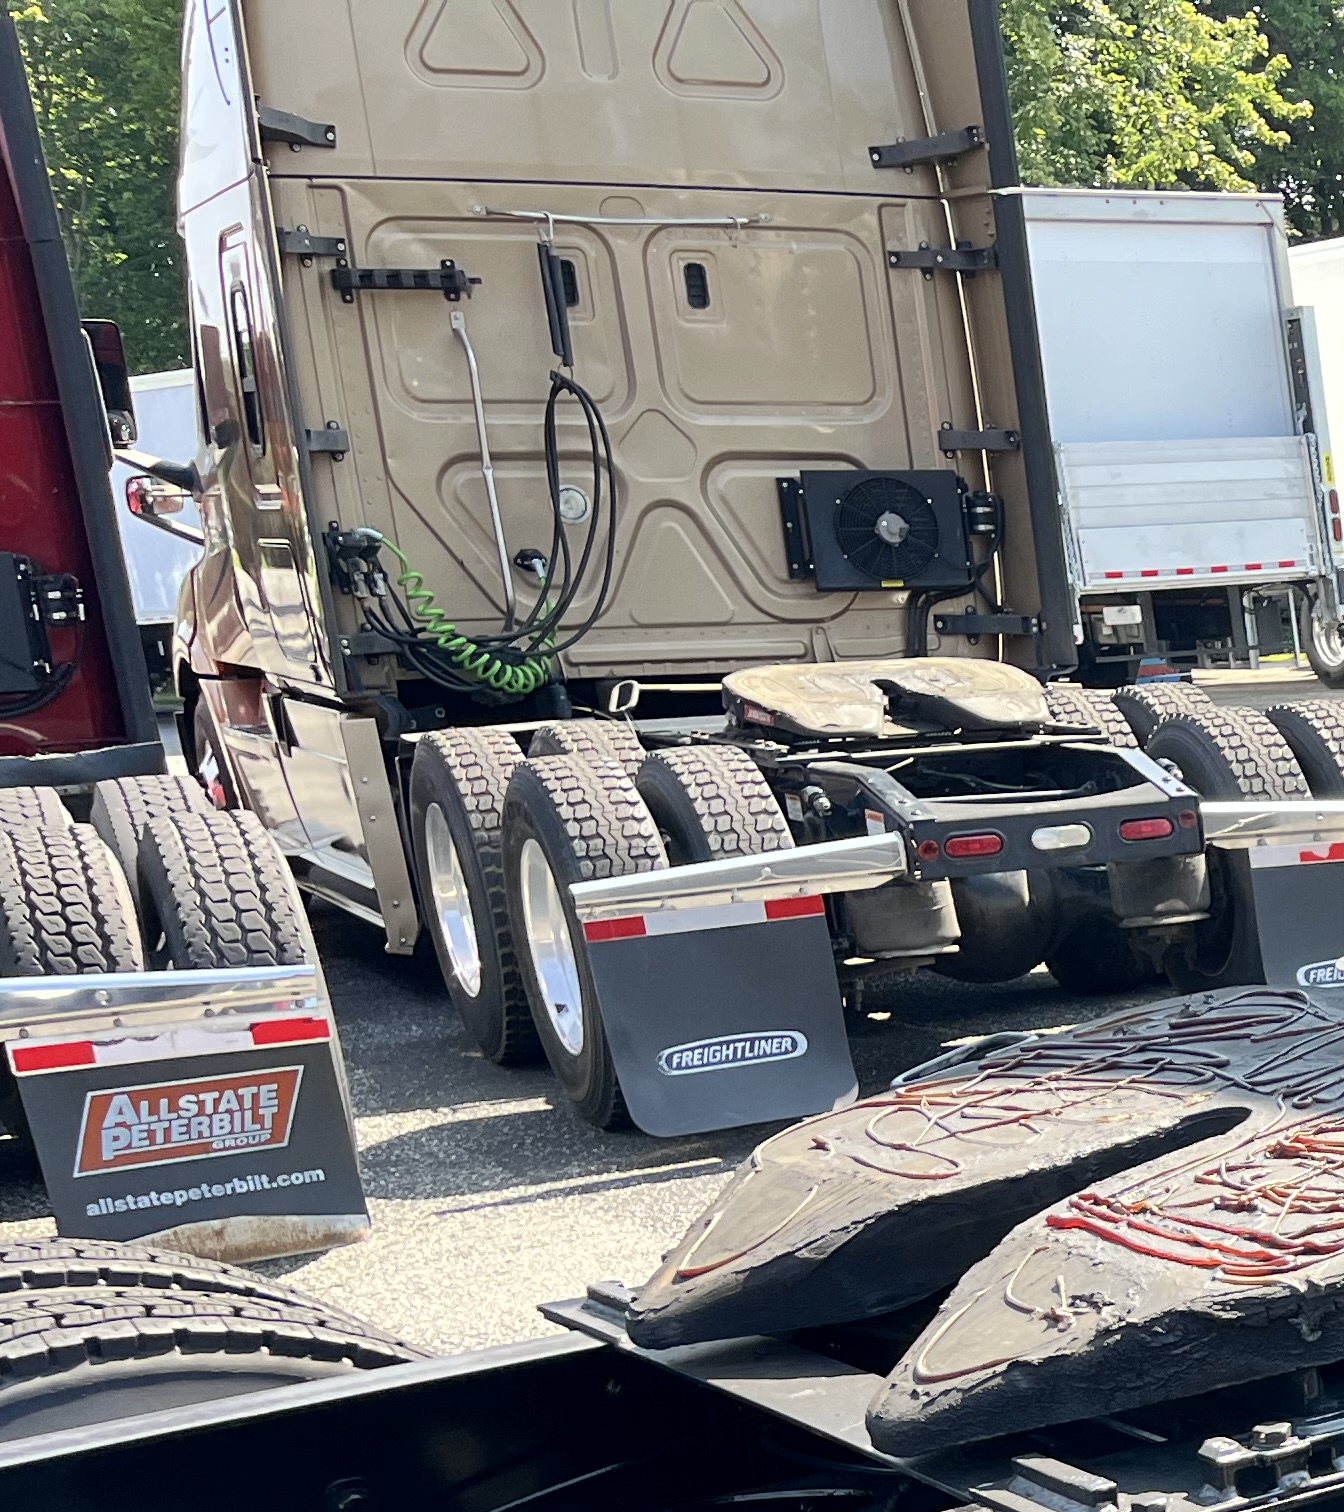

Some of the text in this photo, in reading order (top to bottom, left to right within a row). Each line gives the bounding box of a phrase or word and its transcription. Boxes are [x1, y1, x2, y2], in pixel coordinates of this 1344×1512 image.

[672, 1037, 793, 1068] FREIGHTLINER
[101, 1083, 278, 1129] ALLSTATE
[101, 1106, 278, 1161] PETERBILT
[212, 1132, 272, 1150] GROUP
[86, 1168, 326, 1216] allstatepeterbilt.com
